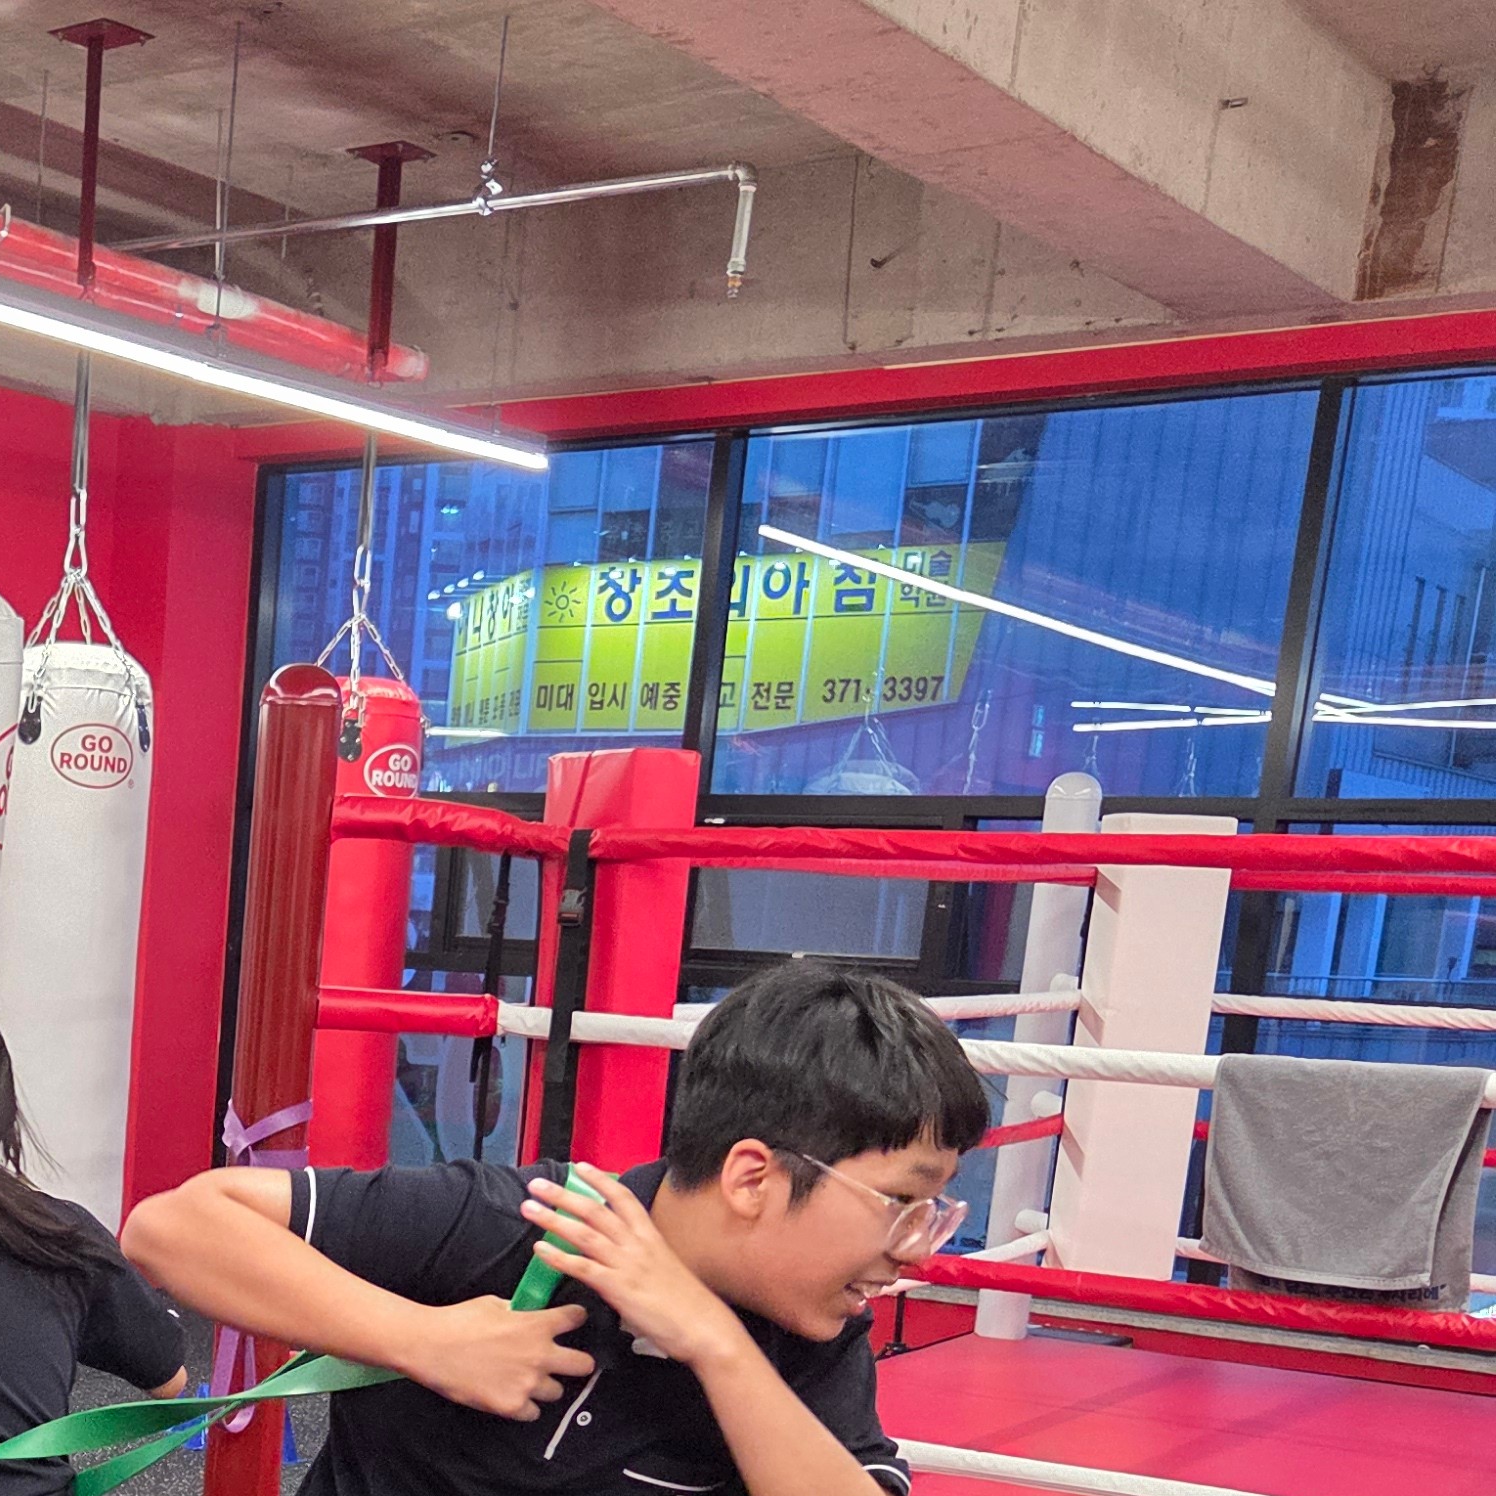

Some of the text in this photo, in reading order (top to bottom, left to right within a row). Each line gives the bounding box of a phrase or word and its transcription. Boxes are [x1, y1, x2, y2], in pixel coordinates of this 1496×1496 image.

[536, 683, 574, 711] 미대
[588, 682, 627, 711] 입시
[639, 682, 681, 711] 예중
[751, 681, 794, 711] 전문
[81, 734, 113, 753] GO
[59, 752, 127, 774] ROUND
[388, 753, 413, 772] GO
